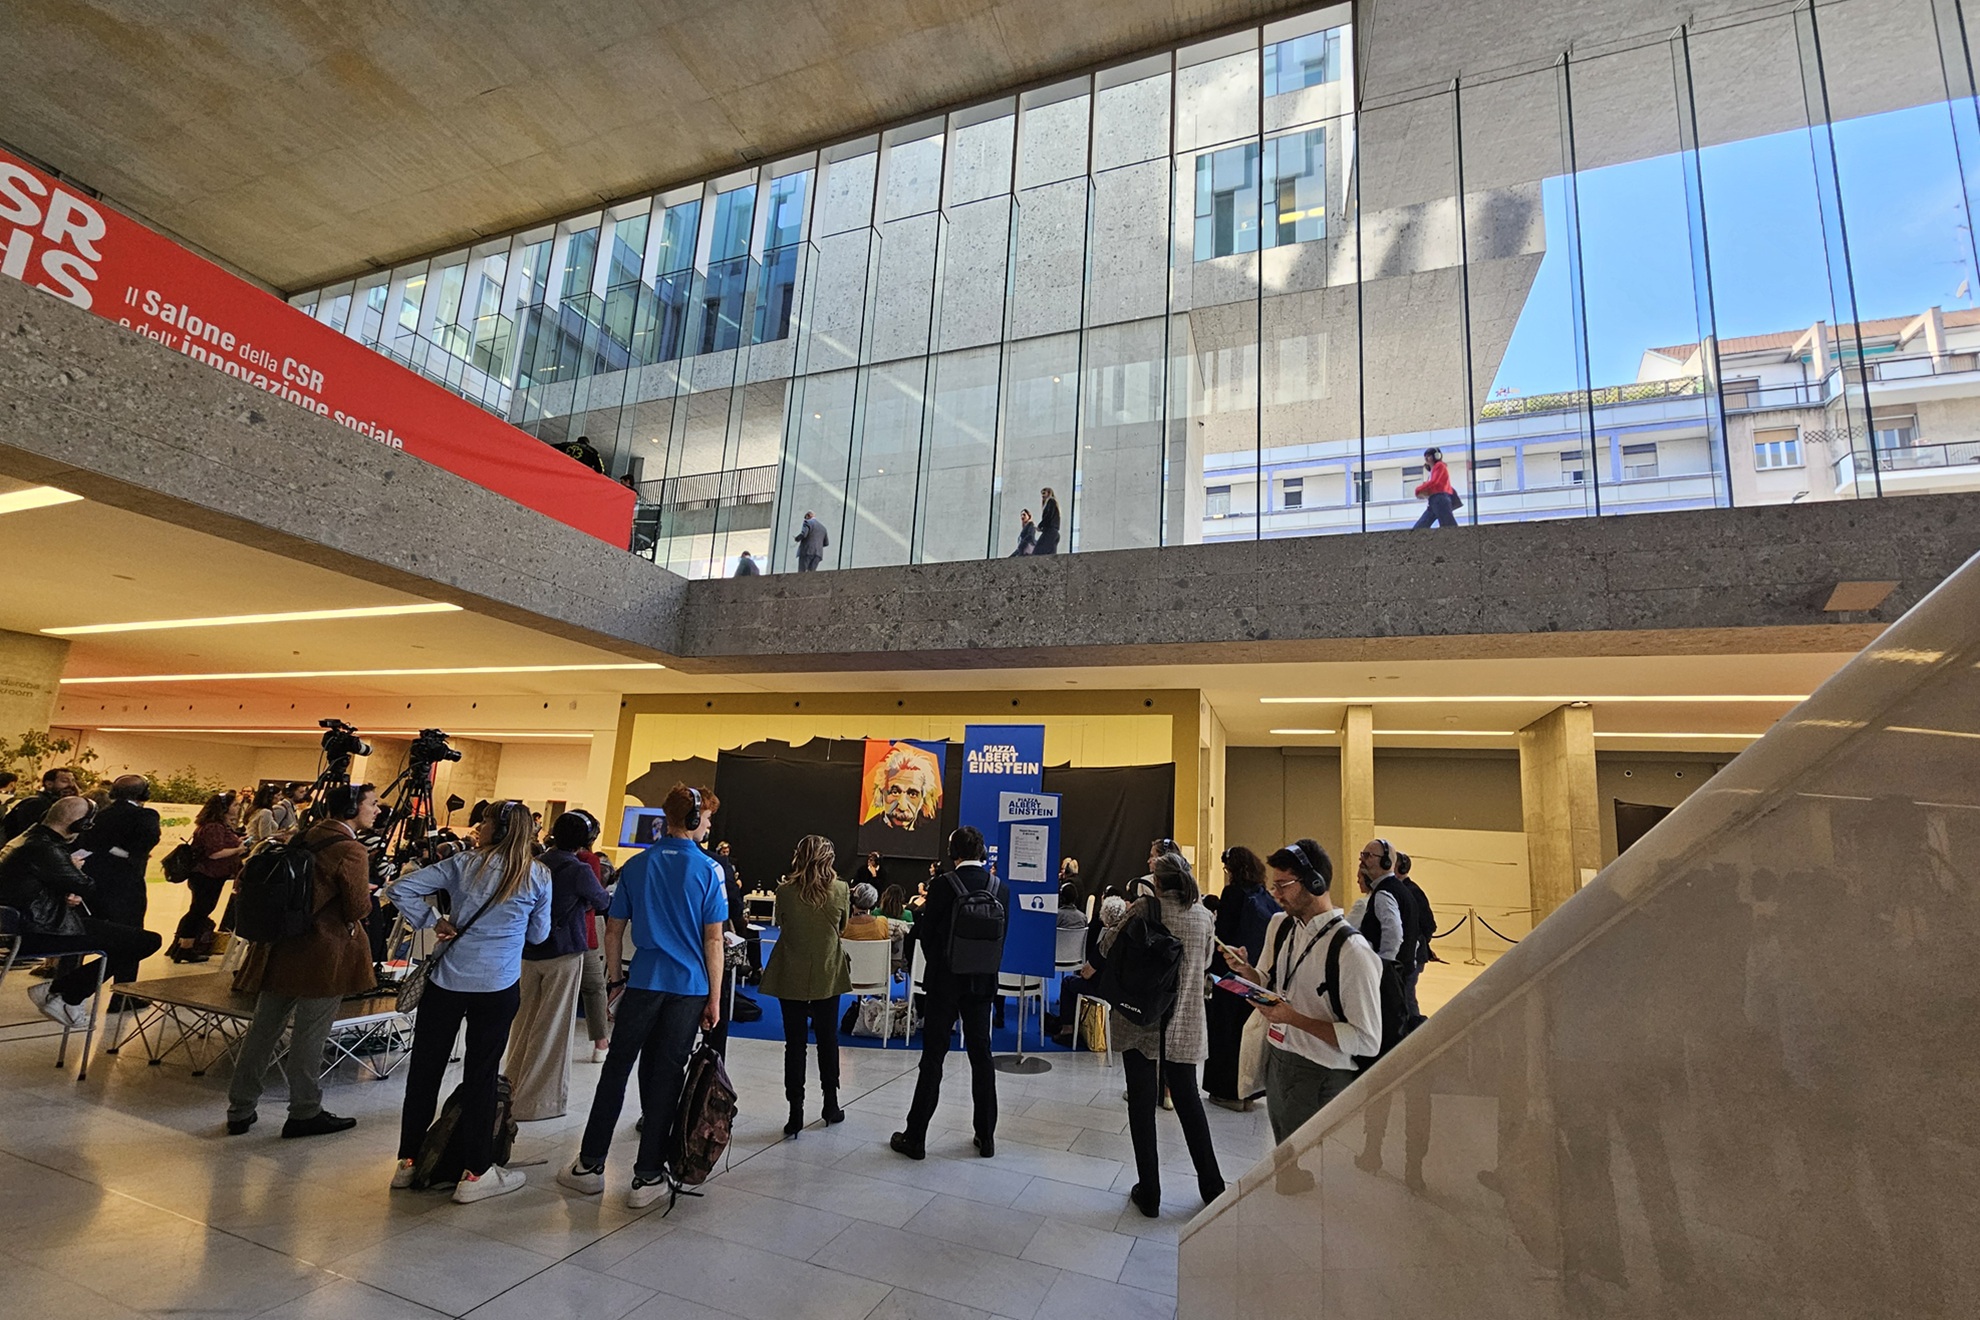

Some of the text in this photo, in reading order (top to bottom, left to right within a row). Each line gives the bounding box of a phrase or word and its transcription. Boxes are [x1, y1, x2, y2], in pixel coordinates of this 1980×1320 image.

[0, 228, 98, 310] IS
[125, 286, 325, 394] Il Salone della CSR
[181, 334, 329, 418] innovazione
[333, 410, 403, 450] sociale
[983, 745, 1016, 753] PIAZZA
[967, 750, 1019, 763] ALBERT
[969, 762, 1039, 775] EINSTEIN
[1008, 800, 1041, 809] ALBERT
[1008, 808, 1053, 817] EINSTEIN
